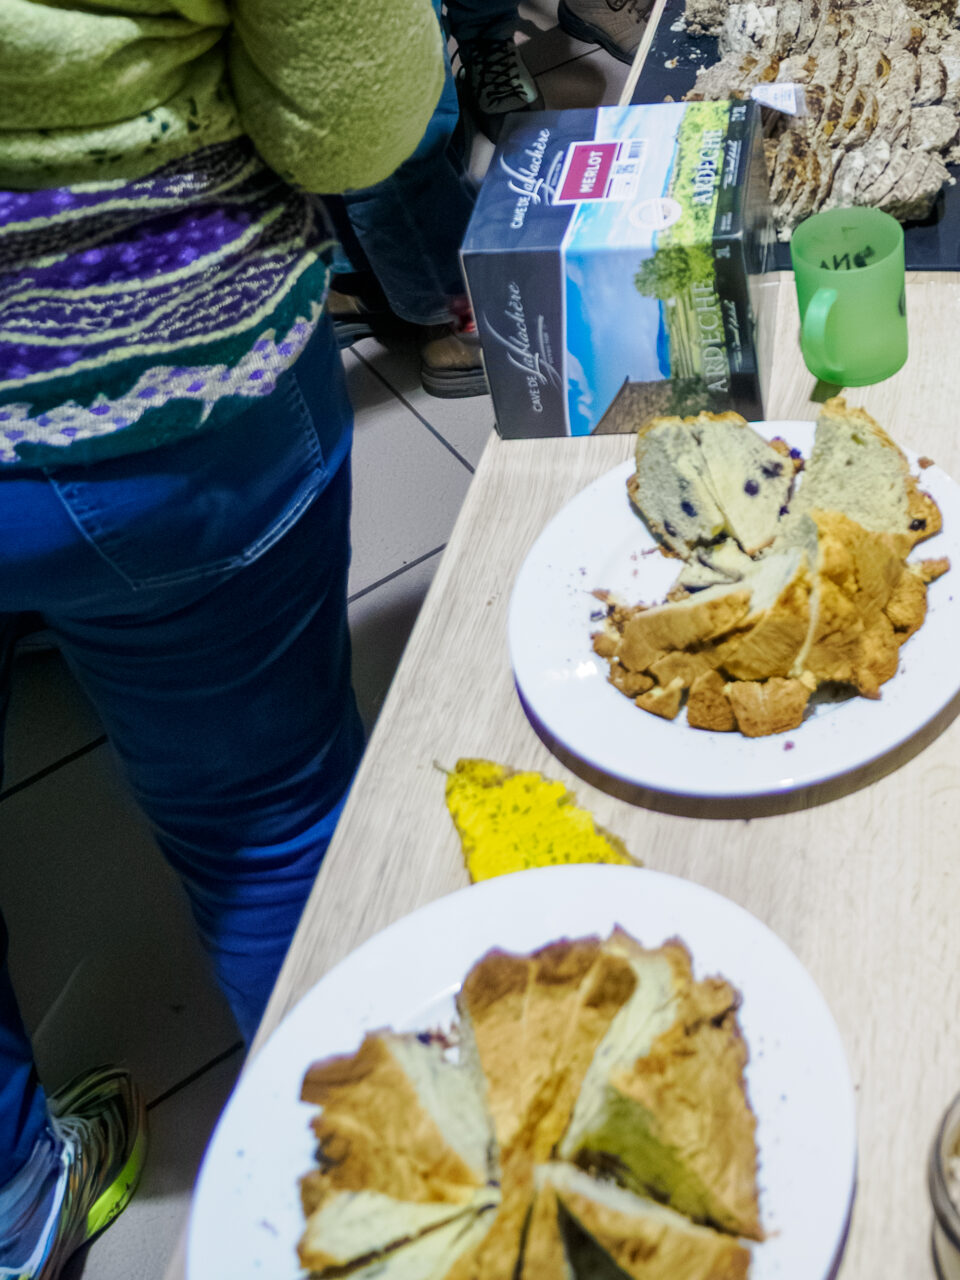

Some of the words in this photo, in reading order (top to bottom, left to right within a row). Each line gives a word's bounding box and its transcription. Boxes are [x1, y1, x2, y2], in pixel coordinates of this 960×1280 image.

[579, 150, 604, 194] MERLOT
[691, 128, 724, 205] ARDECHE
[510, 206, 527, 229] CAVE
[692, 279, 728, 393] ARDECHE
[526, 375, 538, 388] DE
[529, 390, 543, 413] CAVE
